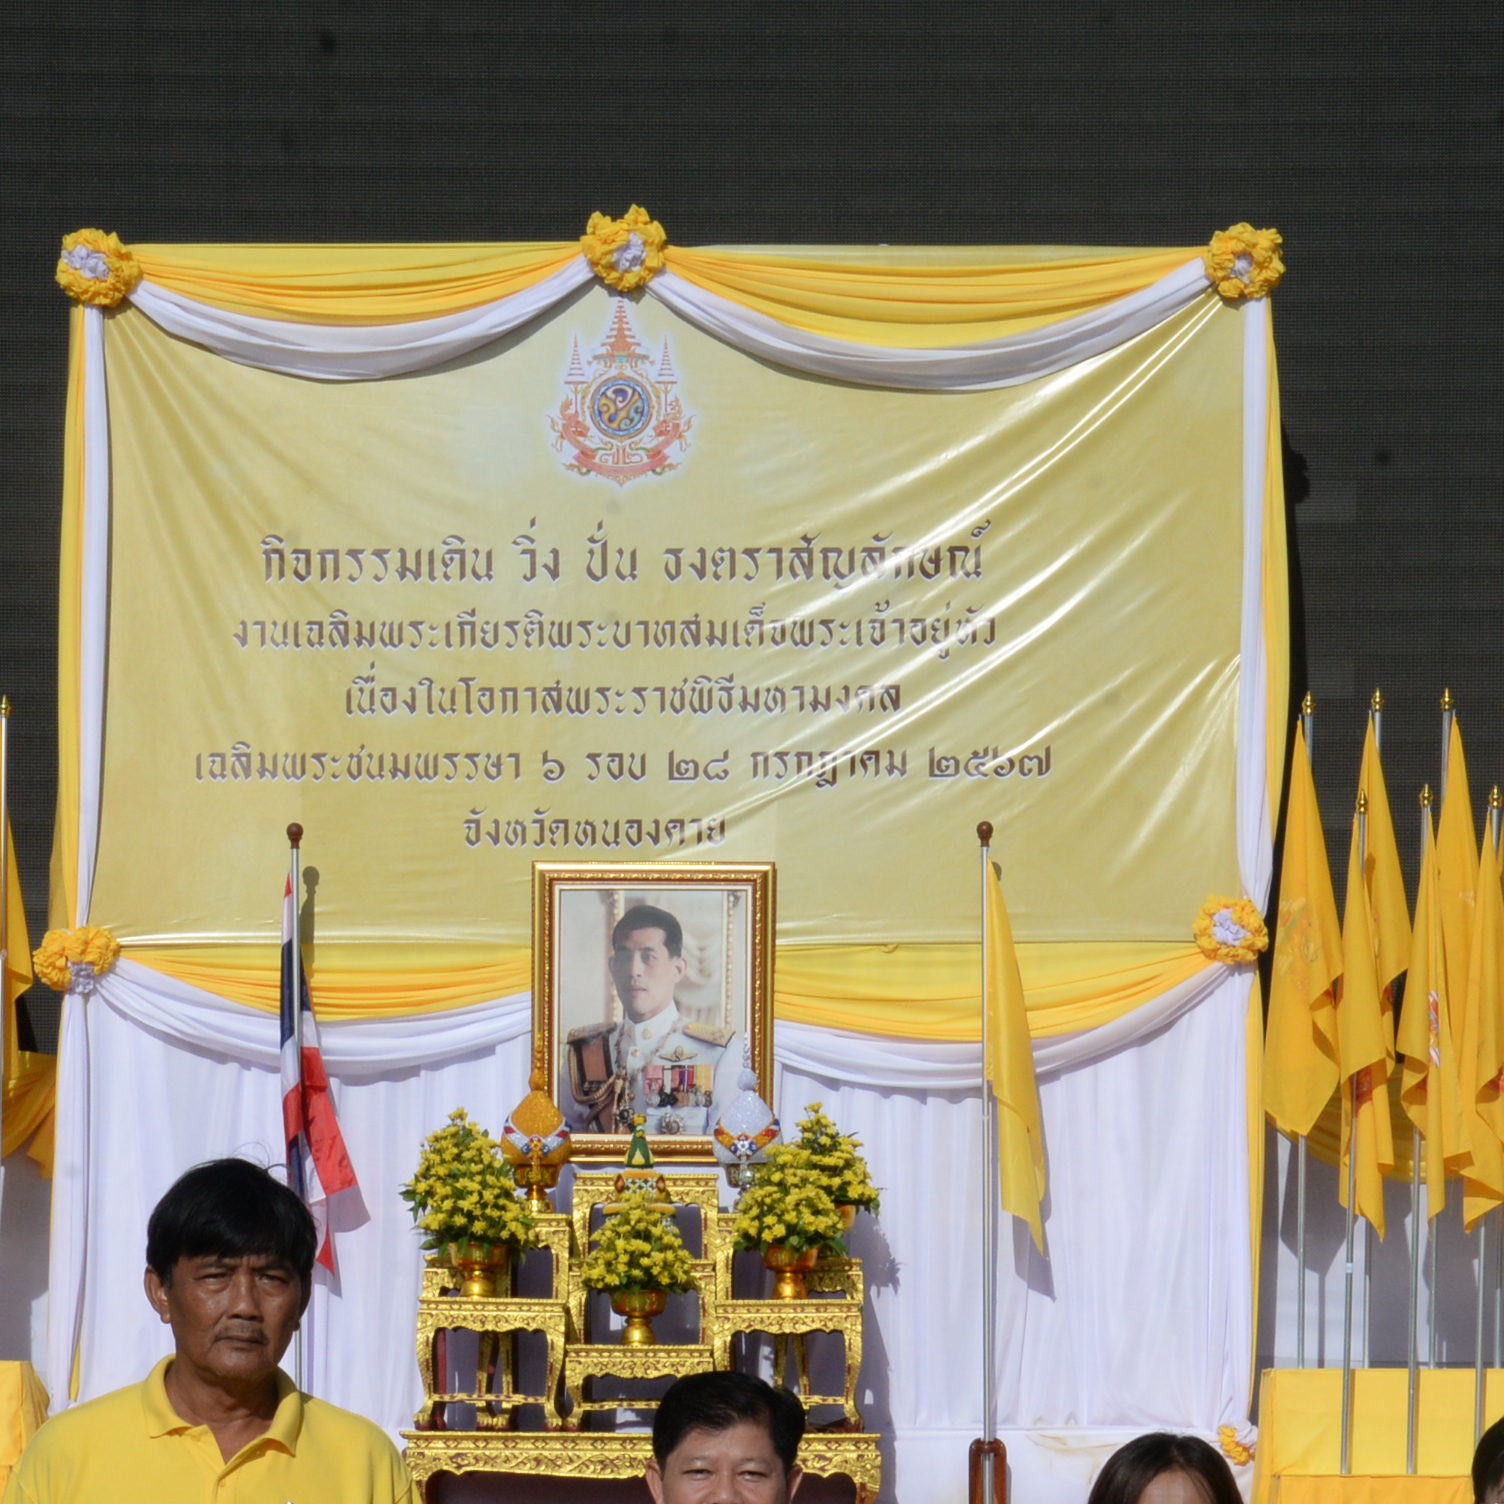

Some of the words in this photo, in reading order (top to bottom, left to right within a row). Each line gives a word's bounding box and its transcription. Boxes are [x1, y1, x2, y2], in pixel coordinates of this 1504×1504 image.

[260, 533, 494, 584] กิจกรรมเดิน
[511, 515, 561, 584] วิ่ง
[586, 519, 637, 584] ปั่น
[663, 518, 992, 590] ธงตราสัญลักษณ์
[232, 600, 996, 660] งานเฉลิมพระเกียรติพระบาทสมเด็จพระเจ้าอยู่หัว
[345, 660, 901, 716] เนื่องในโอกาสพระราชพิธีมหามงคล
[195, 740, 521, 782] เฉลิมพระชนมพรรษา
[541, 749, 566, 782] ๖
[586, 750, 647, 782] รอบ
[667, 748, 730, 782] ๒๘
[750, 748, 908, 789] กรกฎาคม
[928, 745, 1052, 780] ๒๕๖๗
[463, 806, 726, 848] จังหวัดหนองคาย
